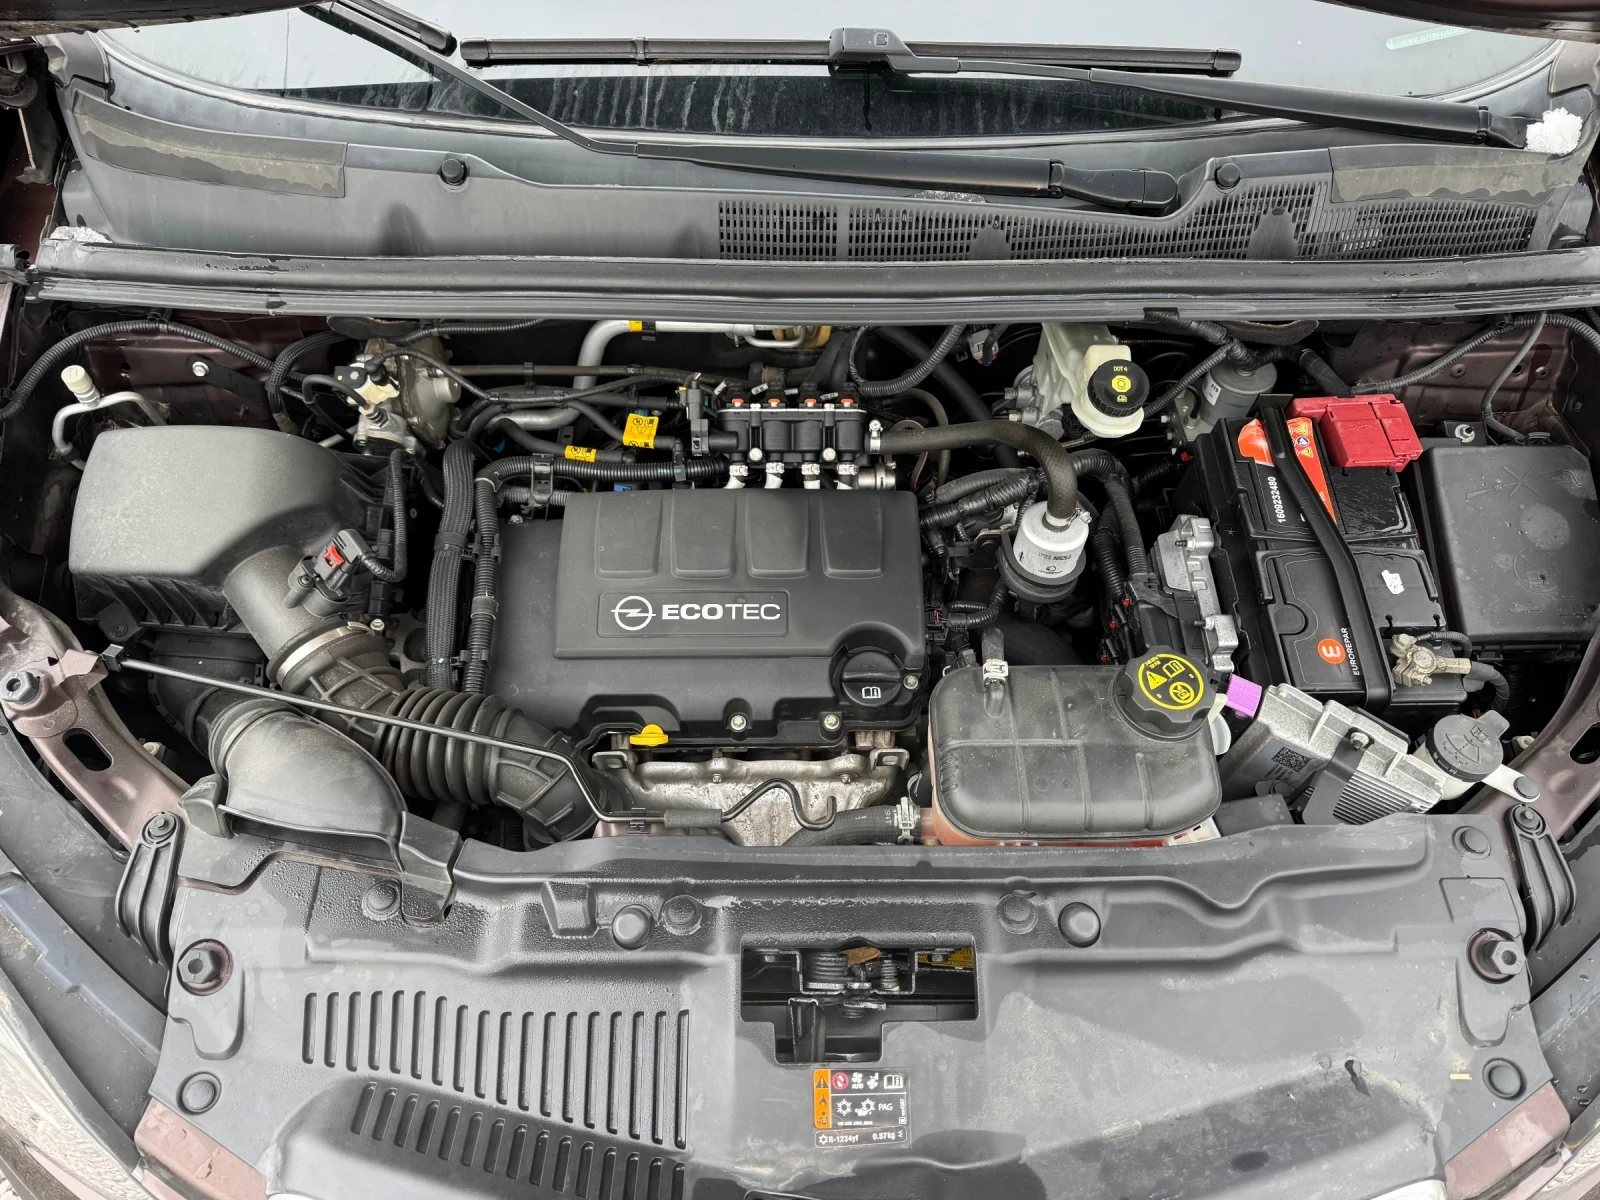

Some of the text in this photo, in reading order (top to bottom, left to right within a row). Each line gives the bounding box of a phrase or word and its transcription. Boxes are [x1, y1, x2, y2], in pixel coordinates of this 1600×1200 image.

[1267, 476, 1286, 524] 1609232480
[662, 603, 781, 620] ECOTEC
[1341, 627, 1360, 676] EUROREPAR
[878, 1103, 893, 1111] PAG
[828, 1134, 859, 1144] R-1234yf
